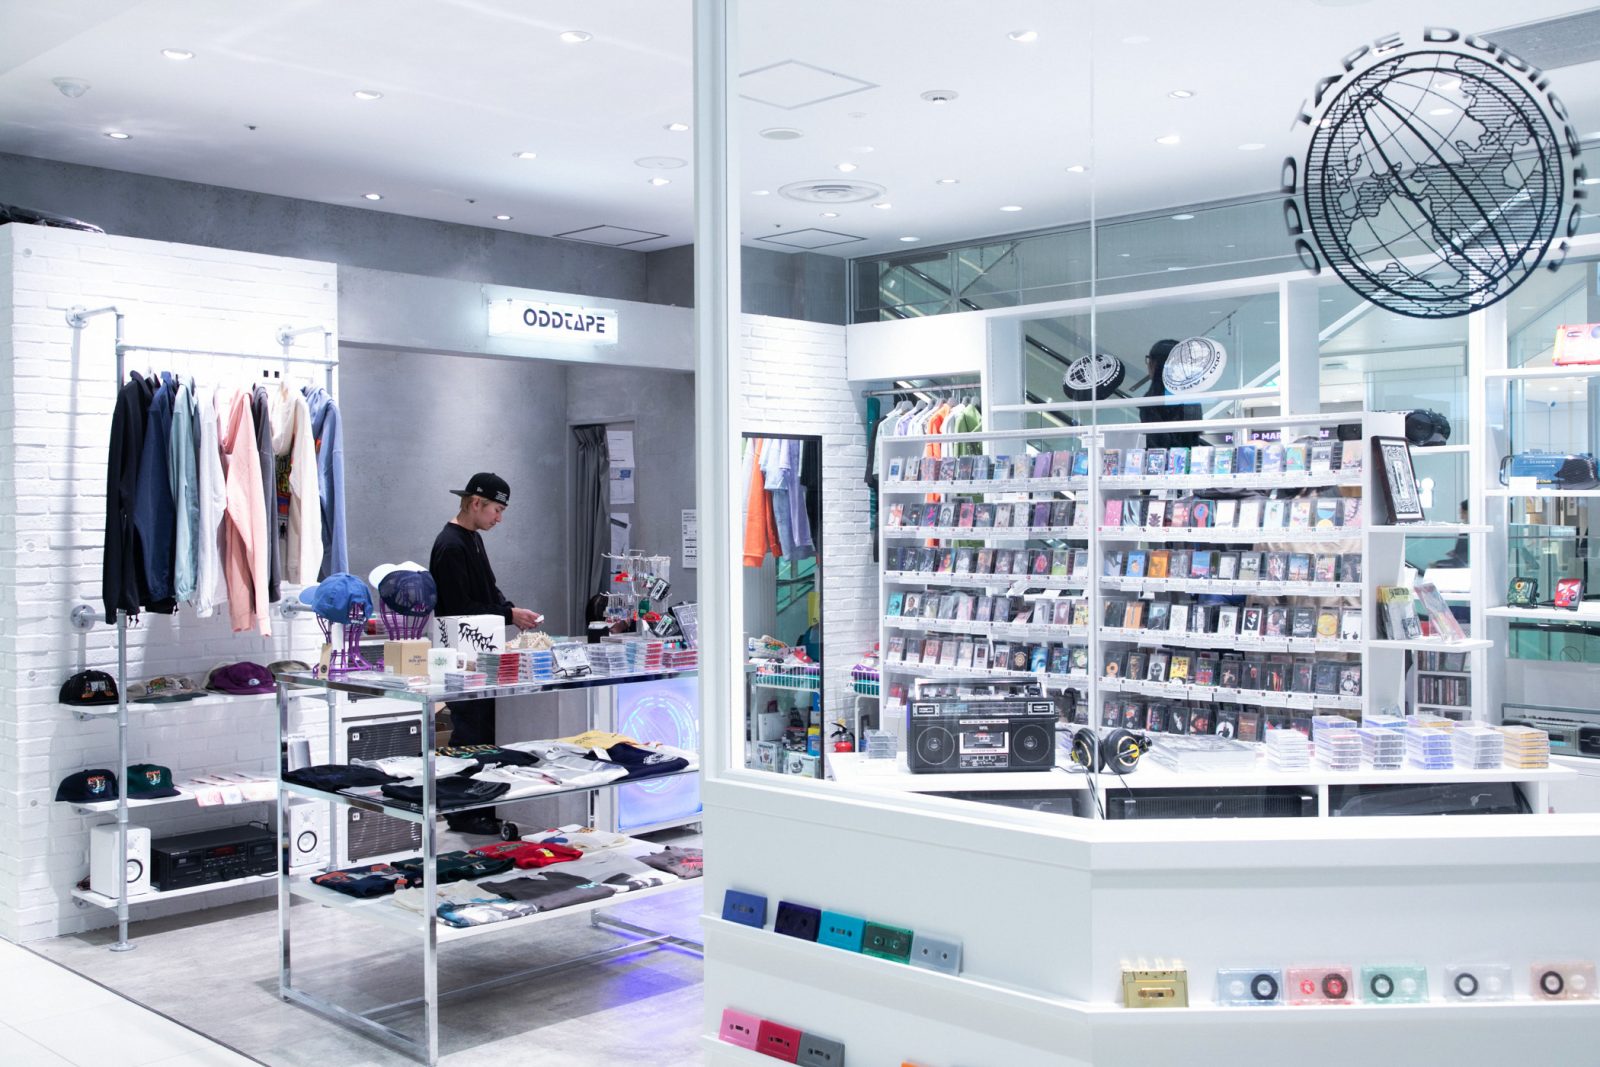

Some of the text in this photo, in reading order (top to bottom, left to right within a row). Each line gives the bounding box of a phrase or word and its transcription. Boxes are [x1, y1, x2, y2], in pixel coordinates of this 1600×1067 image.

[1290, 31, 1405, 132] TAPE
[1280, 156, 1321, 275] ODD
[523, 308, 605, 334] ODDTAPE
